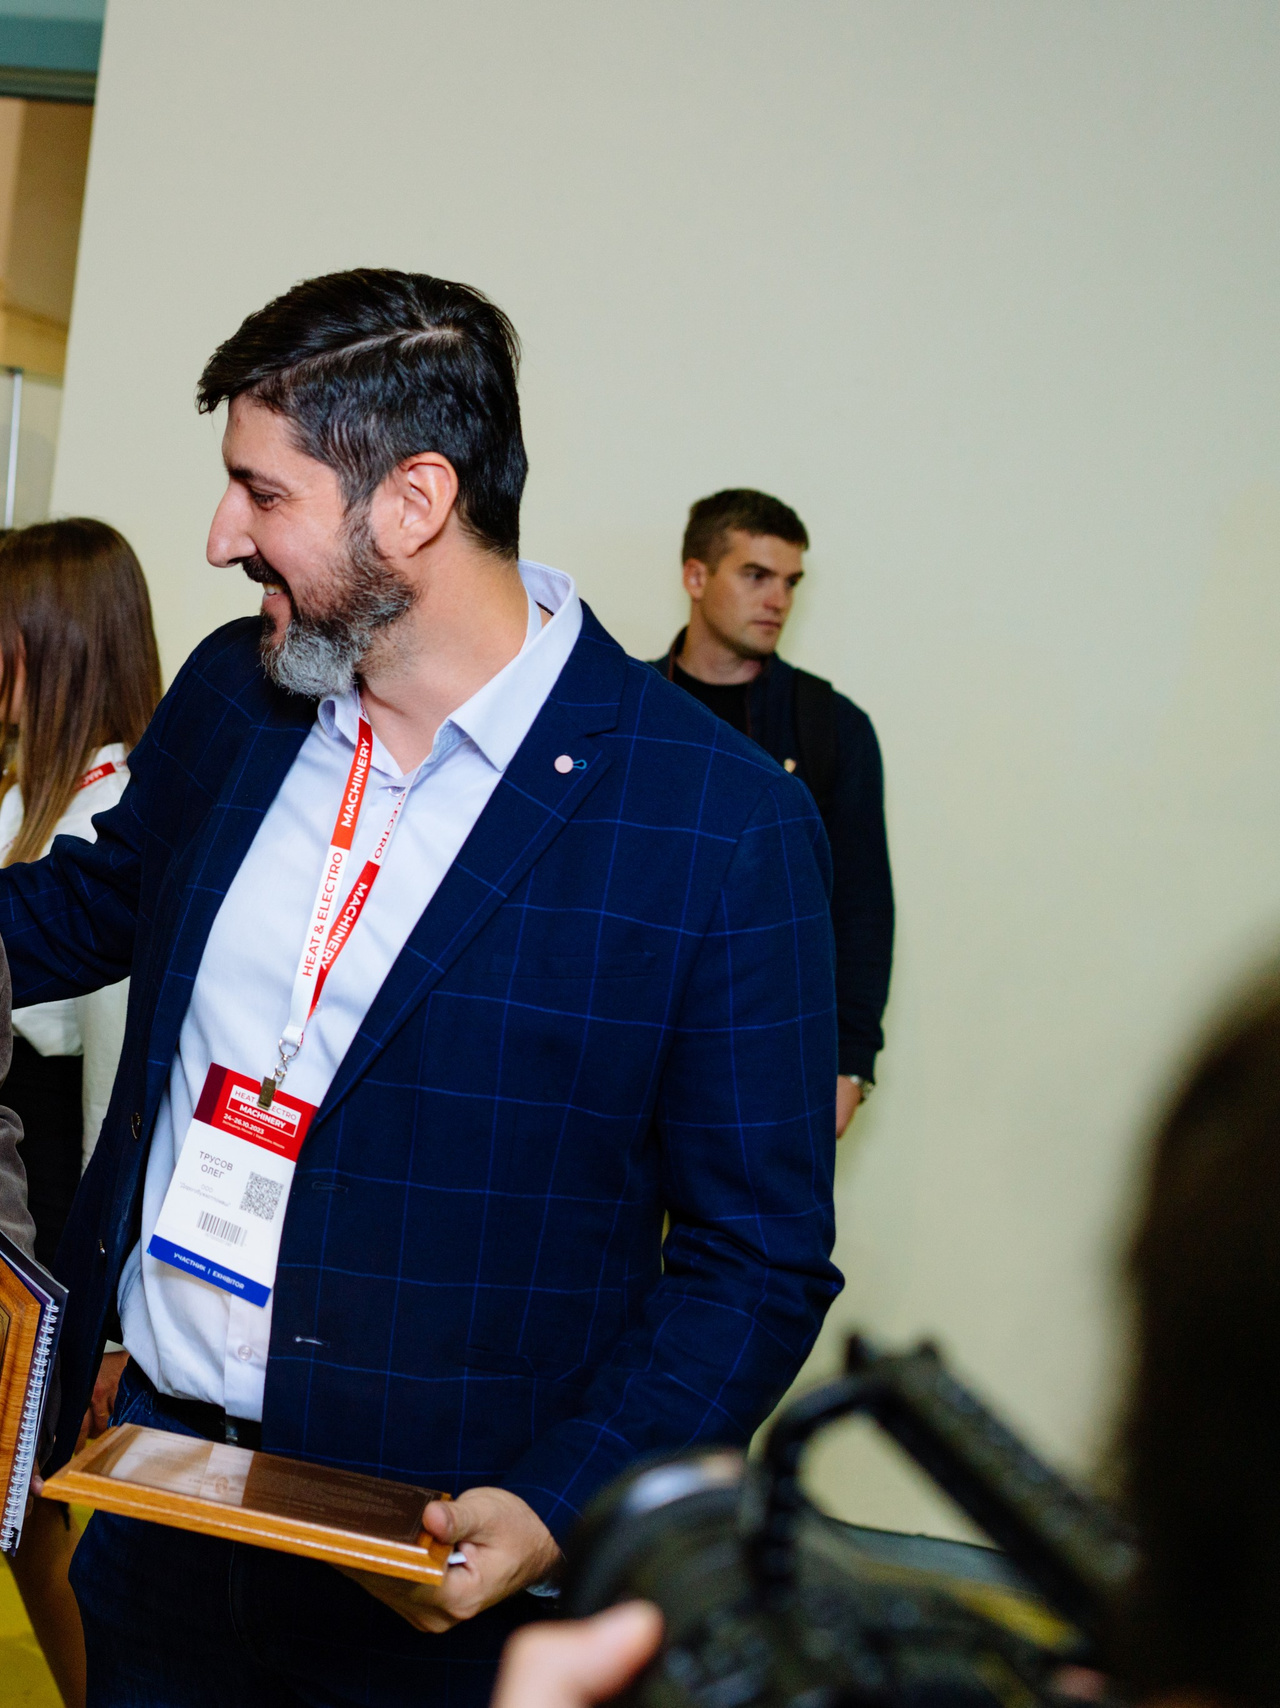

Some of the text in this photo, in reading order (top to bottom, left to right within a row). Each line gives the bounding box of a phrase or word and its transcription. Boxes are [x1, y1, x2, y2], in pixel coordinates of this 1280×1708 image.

[341, 737, 370, 828] MACHINERY
[302, 852, 343, 977] HEAT & ELECTRO
[320, 882, 368, 971] MACHINERY
[234, 1090, 255, 1102] HEAT
[239, 1103, 287, 1129] MACHINERY
[199, 1150, 234, 1171] ТРУСОВ
[200, 1163, 225, 1179] ОЛЕГ
[173, 1252, 207, 1272] УЧАСТНИК
[212, 1270, 246, 1290] EXHIBITOR
